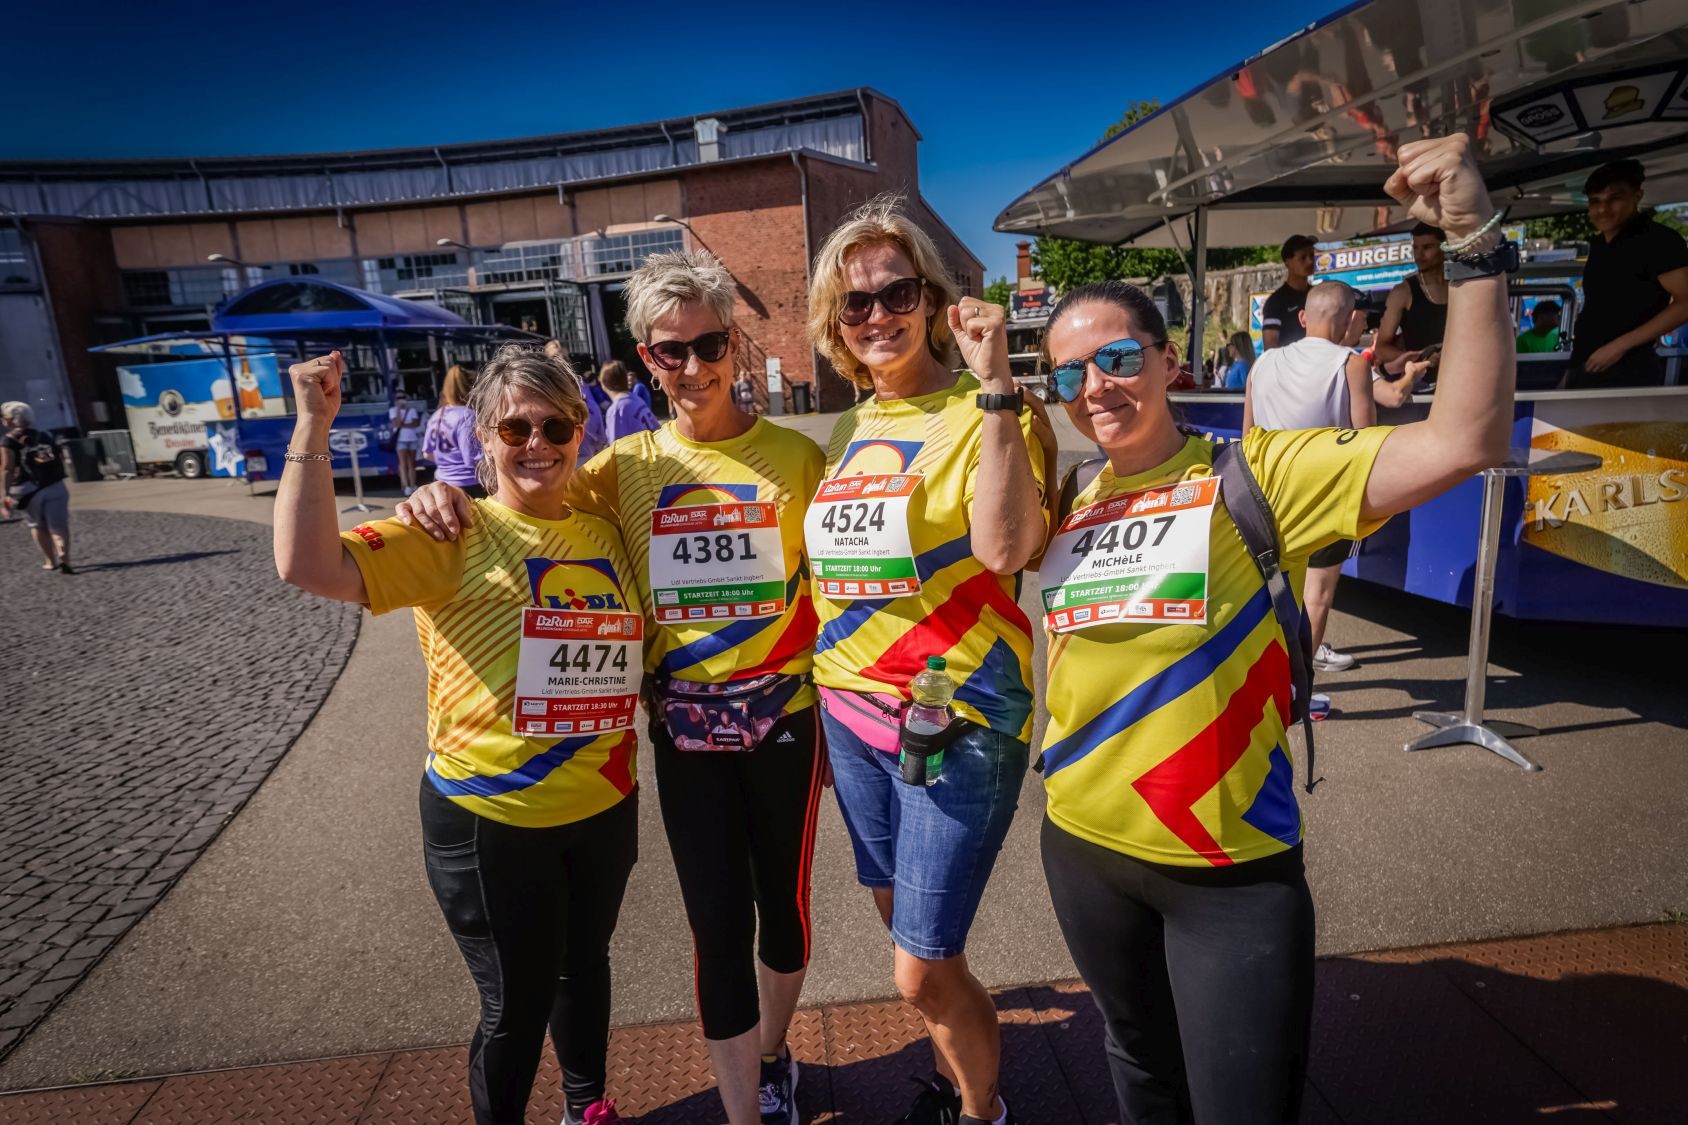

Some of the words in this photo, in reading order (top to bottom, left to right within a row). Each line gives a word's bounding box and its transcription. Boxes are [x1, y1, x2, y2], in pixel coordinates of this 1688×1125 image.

[1335, 244, 1413, 268] BURGER
[821, 502, 886, 533] 4524
[834, 537, 869, 546] NATACHA
[1071, 515, 1176, 557] 4407
[673, 533, 757, 564] 4381
[1092, 553, 1143, 569] MICHèLE
[1126, 565, 1146, 574] Sankt
[683, 591, 720, 599] STARTZEIT
[721, 589, 740, 597] 18:00
[1070, 585, 1113, 598] STARTZEIT
[1114, 583, 1140, 593] 18:00
[549, 644, 628, 673] 4474
[548, 676, 626, 686] MARIE-CHRISTINE
[553, 703, 590, 711] STARTZEIT
[591, 702, 607, 710] 18:30
[608, 701, 618, 709] Uhr
